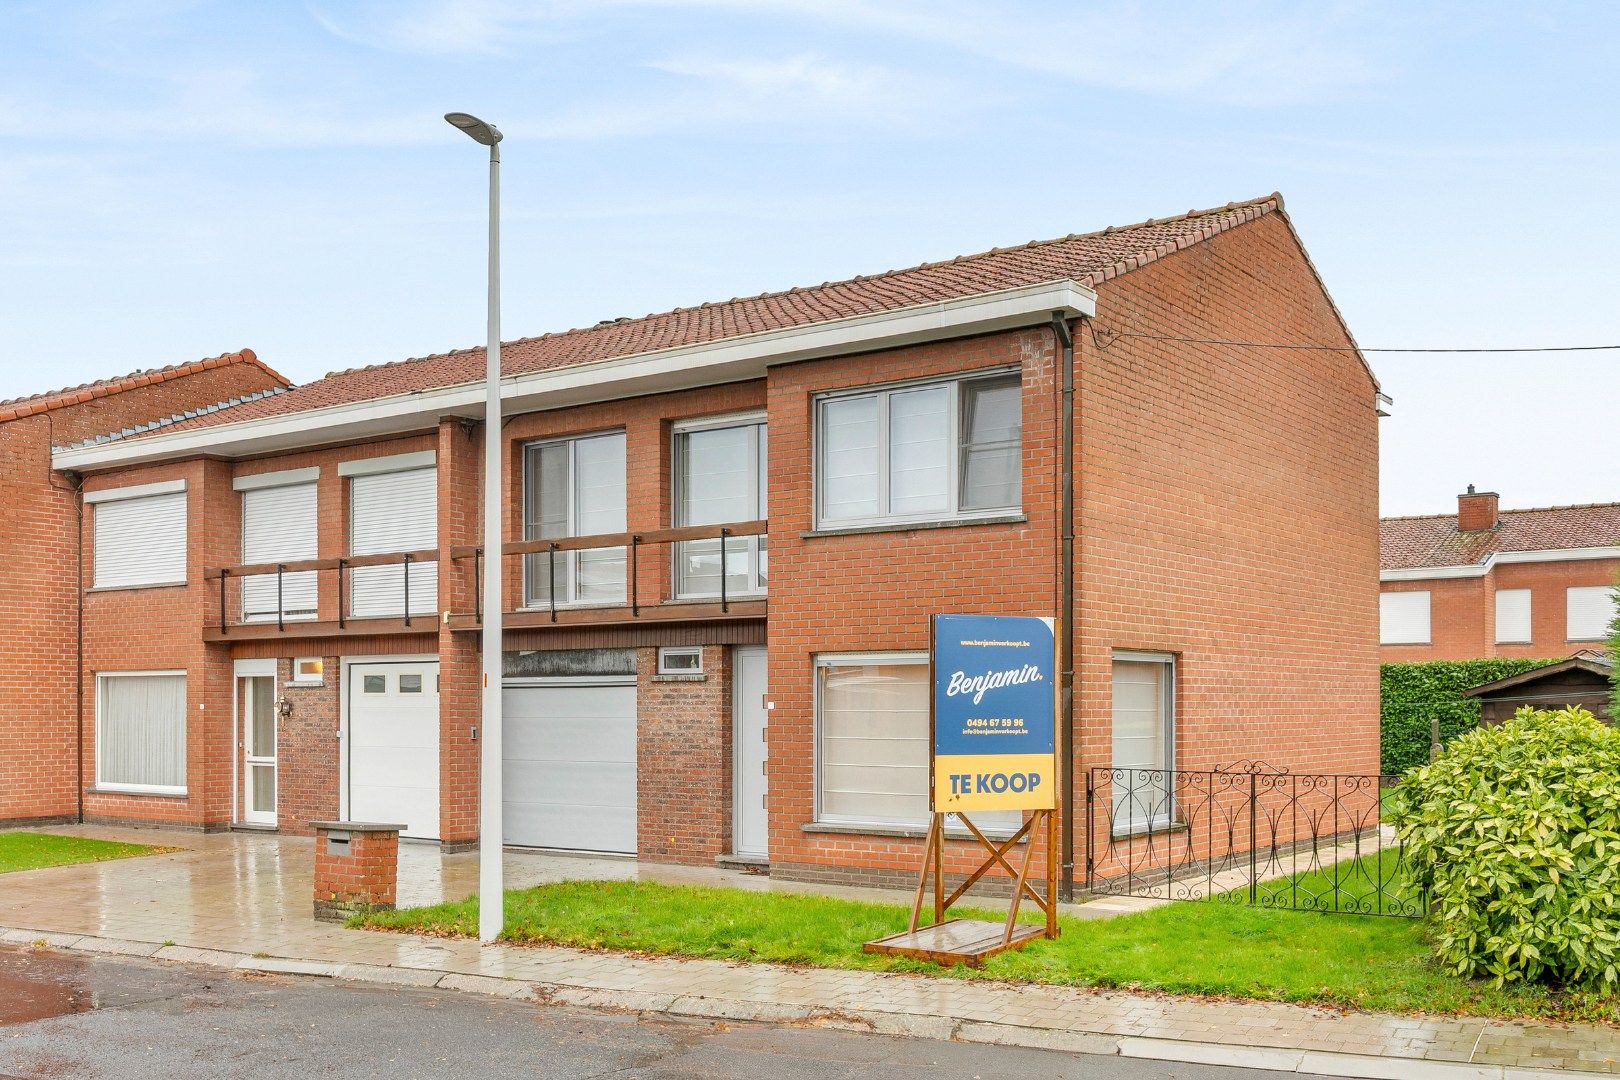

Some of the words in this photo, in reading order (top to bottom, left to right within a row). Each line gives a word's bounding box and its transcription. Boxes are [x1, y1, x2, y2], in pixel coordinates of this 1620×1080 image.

[967, 718, 988, 727] 0494
[989, 718, 999, 727] 67
[1001, 718, 1012, 727] 59
[1013, 718, 1024, 727] 96
[949, 774, 972, 794] TE
[976, 772, 1041, 794] KOOP
